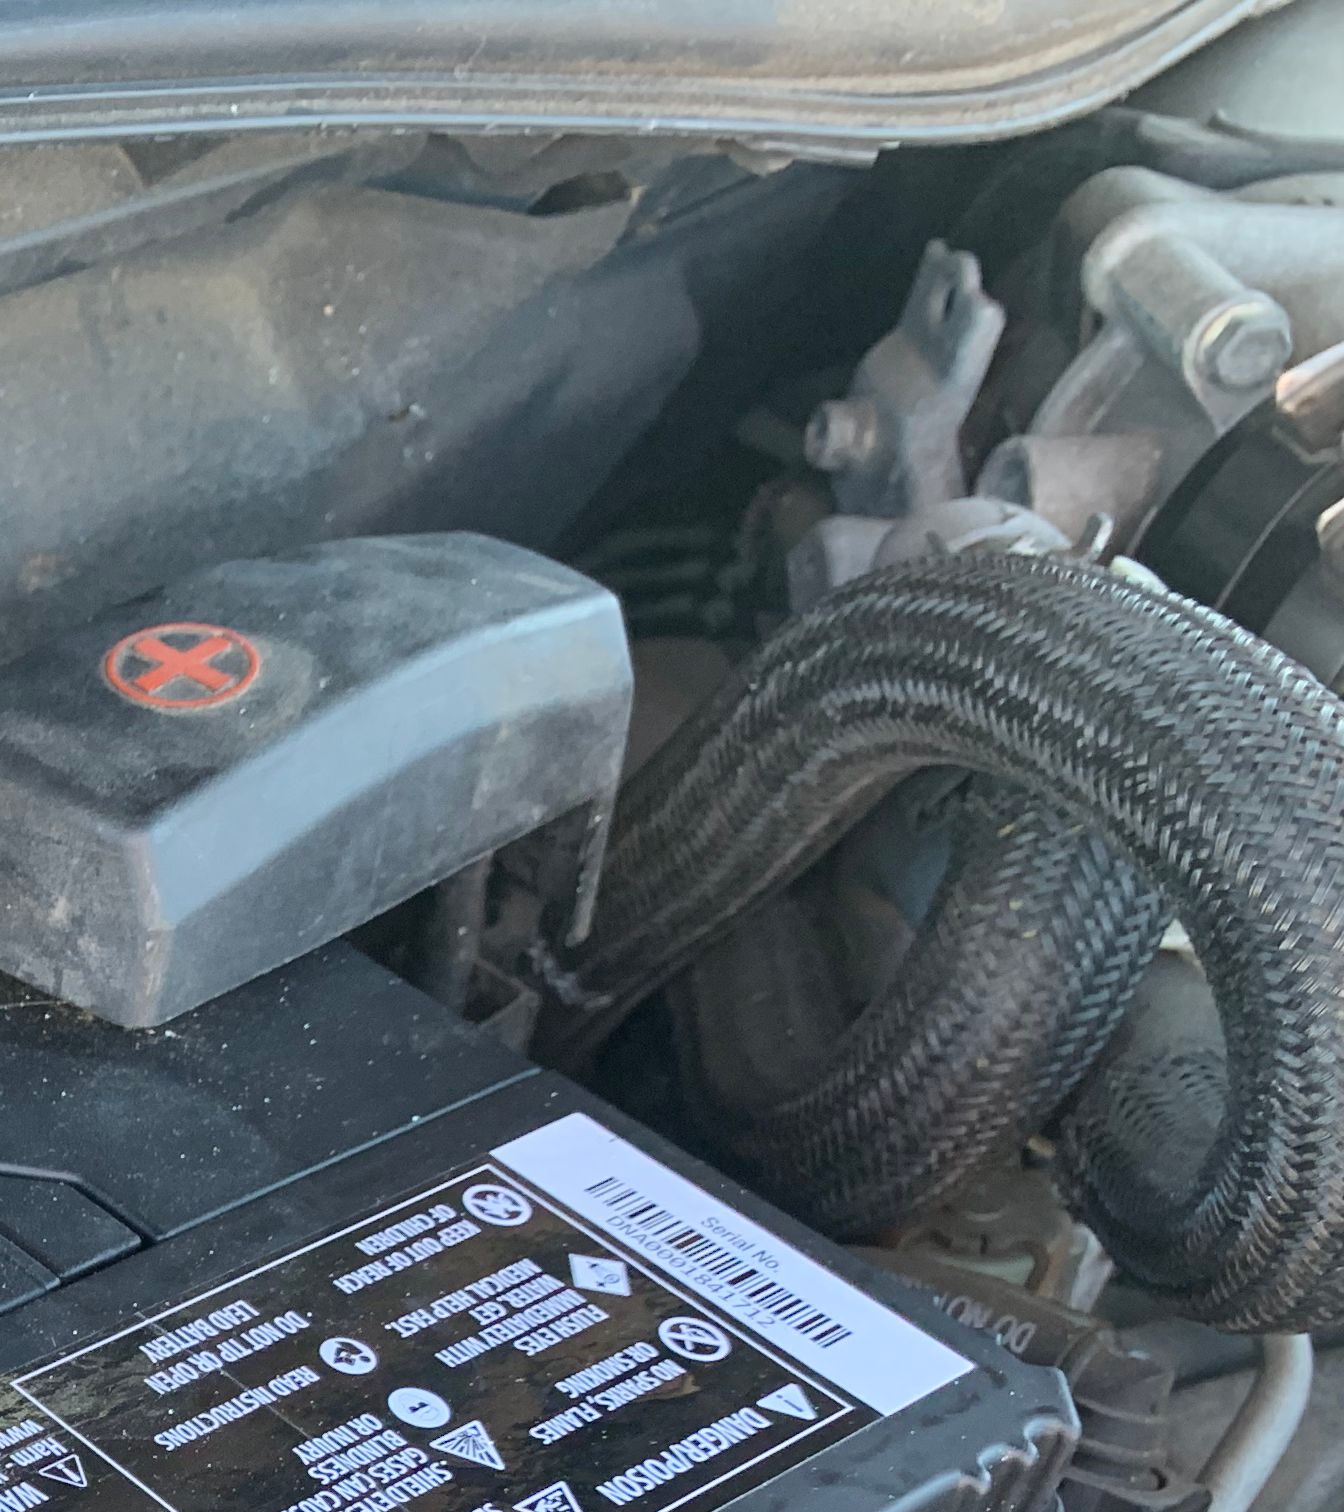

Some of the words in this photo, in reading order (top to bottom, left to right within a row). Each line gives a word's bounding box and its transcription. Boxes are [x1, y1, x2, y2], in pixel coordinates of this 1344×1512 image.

[426, 1203, 458, 1223] OF
[353, 1213, 437, 1256] CHILDREN
[402, 1236, 445, 1262] OUT
[434, 1218, 482, 1247] KEEP
[698, 1216, 757, 1252] Serial
[749, 1249, 783, 1271] No.
[331, 1261, 393, 1294] REACH
[381, 1251, 413, 1272] OF
[603, 1215, 782, 1327] DNA0001841712
[463, 1257, 543, 1300] MEDICAL
[495, 1273, 566, 1309] WATER.
[206, 1299, 260, 1331] LEAD
[427, 1291, 475, 1319] HELP
[466, 1300, 509, 1326] GET
[476, 1288, 587, 1348] IMMEDIATELY
[548, 1303, 610, 1338] FLUSH
[238, 1321, 286, 1351] NOT
[271, 1310, 311, 1334] DO
[383, 1308, 438, 1339] FAST.
[137, 1318, 220, 1364] BATTERY
[213, 1337, 254, 1363] TIP
[433, 1336, 490, 1368] WITH
[511, 1326, 563, 1357] EYES
[621, 1340, 660, 1363] OR
[142, 1361, 201, 1395] OPEN
[186, 1350, 225, 1374] OR
[553, 1351, 638, 1399] SMOKING
[648, 1358, 687, 1382] NO
[265, 1365, 321, 1397] READ
[584, 1369, 663, 1412] SPARKS,
[152, 1385, 278, 1452] INSTRUCTIONS
[345, 1412, 384, 1436] OR
[527, 1401, 603, 1445] FLAMES
[8, 1436, 69, 1469] Harm
[289, 1424, 360, 1466] INJURY
[306, 1429, 408, 1485] BLINDNESS
[594, 1406, 772, 1506] DANGER/POISON
[365, 1446, 430, 1484] GASES
[330, 1470, 378, 1501] CAN
[383, 1461, 454, 1504] SHIELD
